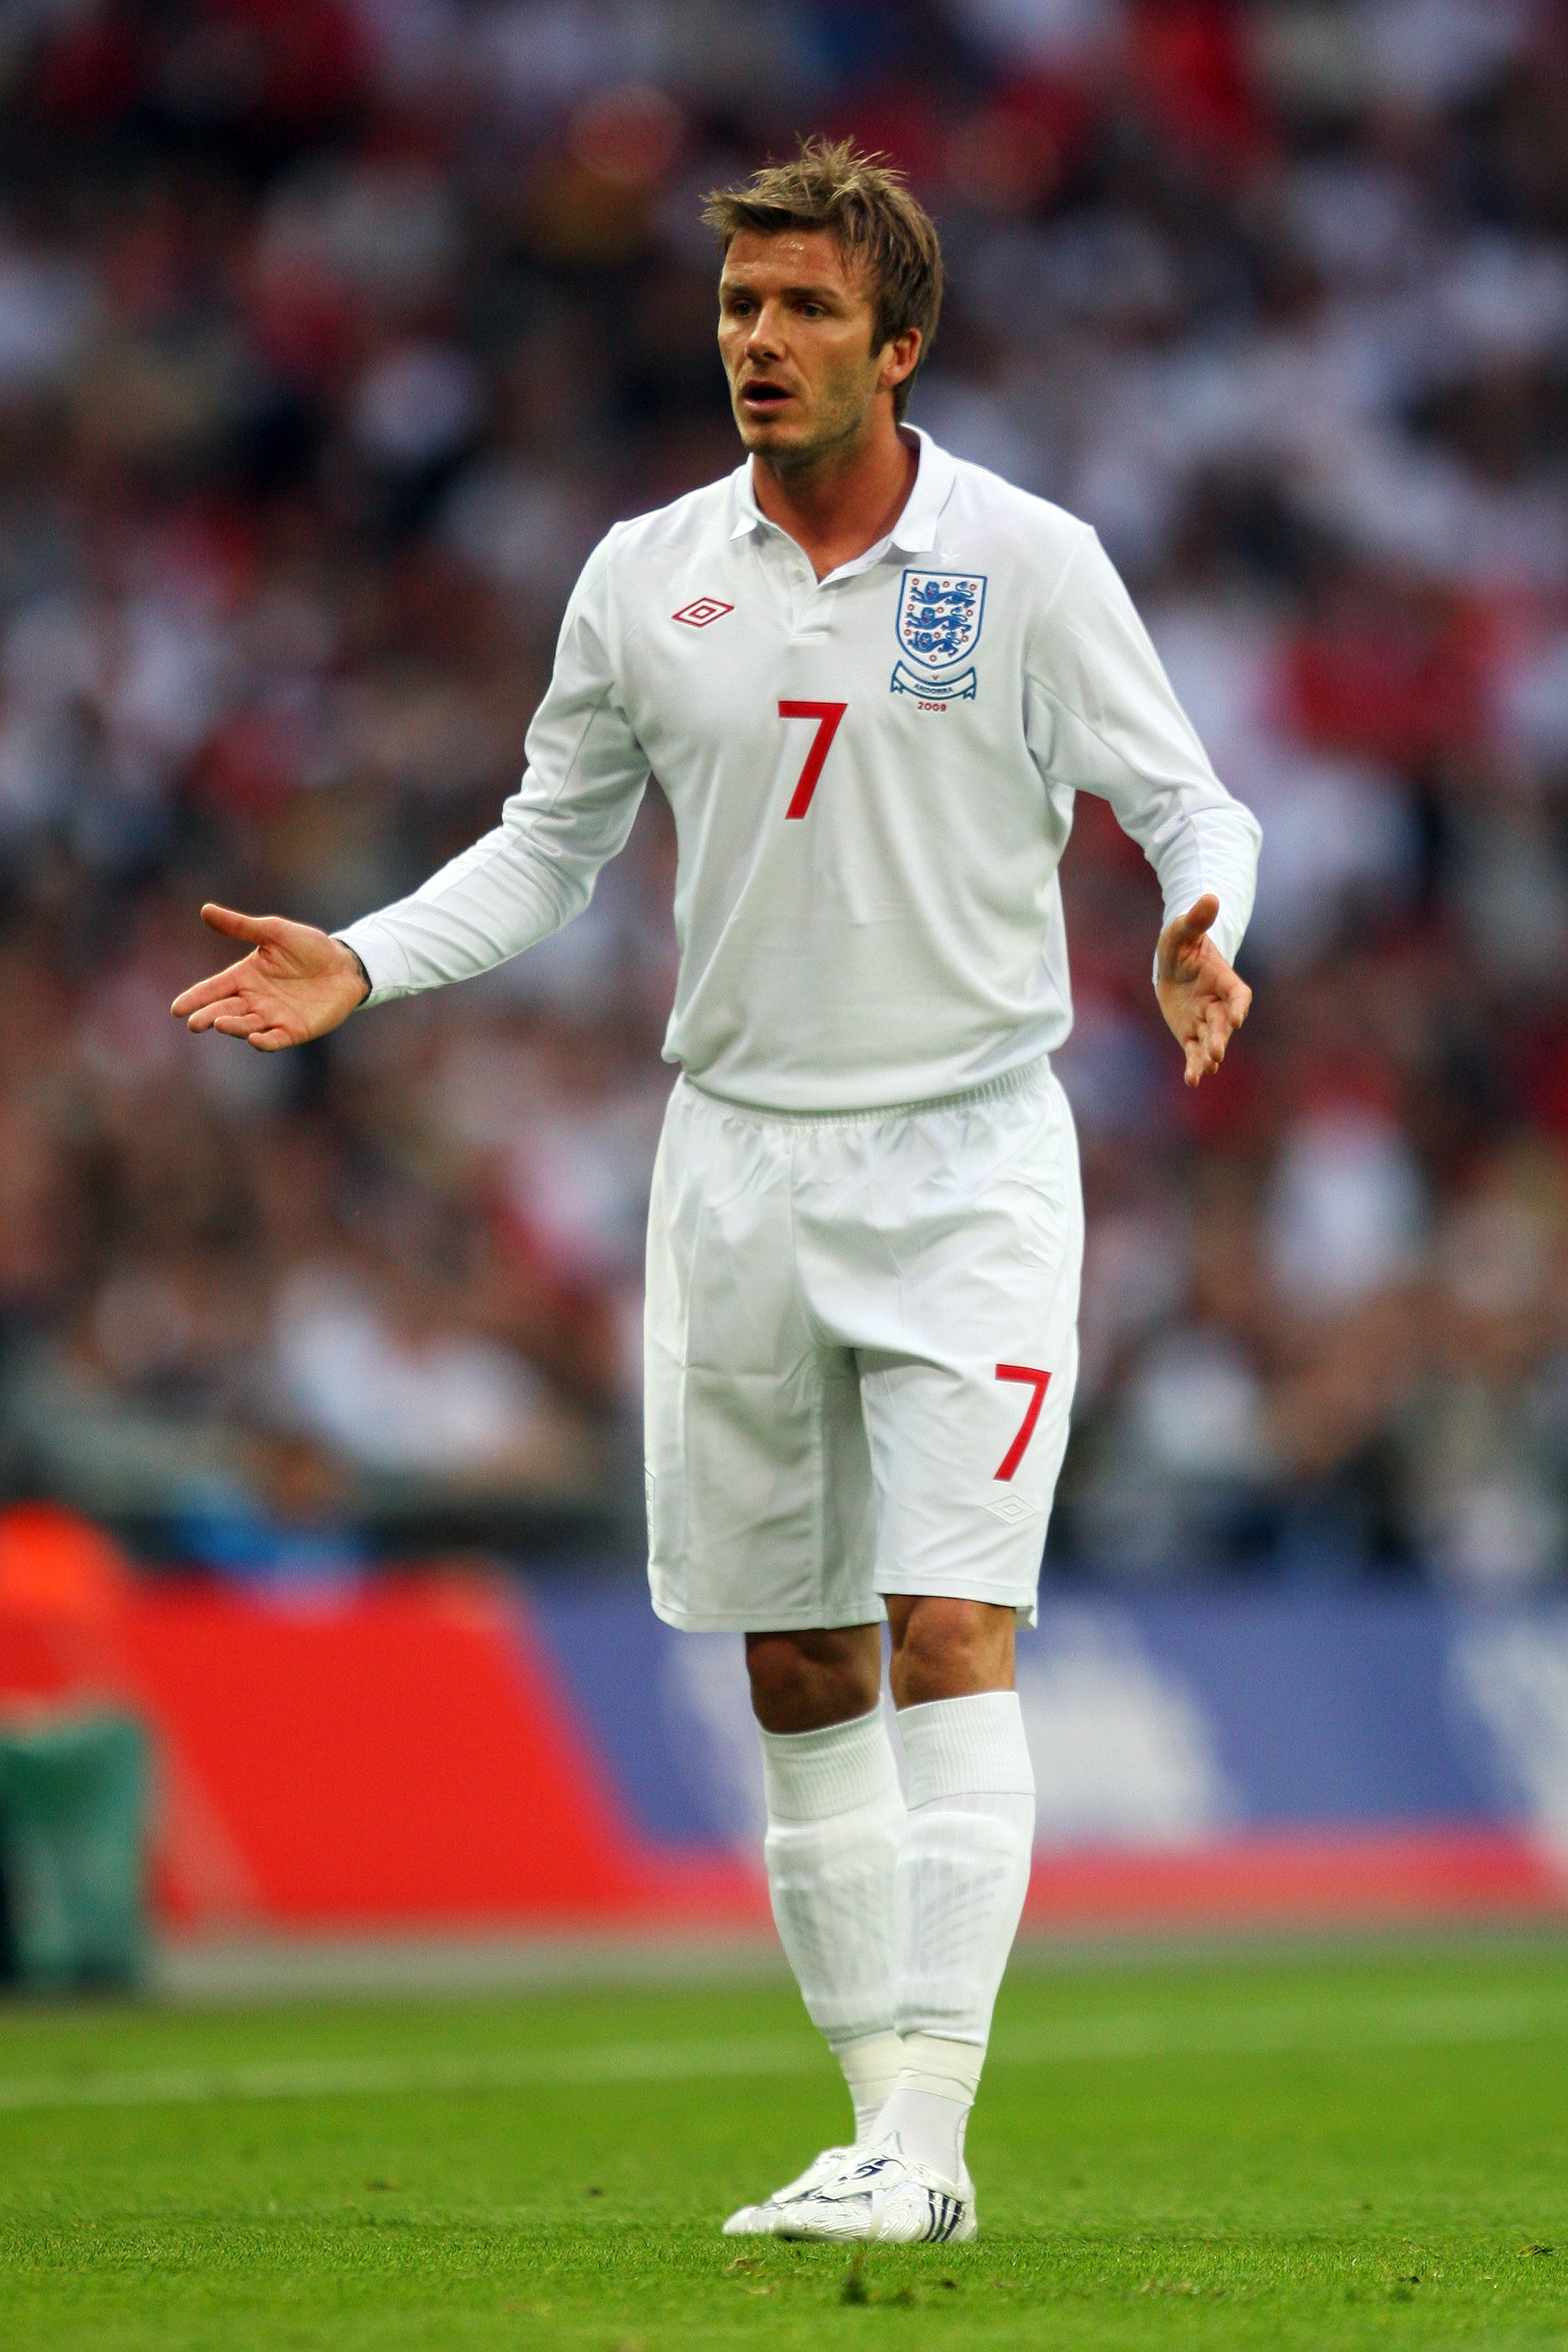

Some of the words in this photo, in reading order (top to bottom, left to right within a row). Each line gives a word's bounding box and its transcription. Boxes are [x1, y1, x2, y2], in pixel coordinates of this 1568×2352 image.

[778, 701, 848, 820] 7
[917, 702, 947, 712] 2009
[993, 1364, 1052, 1481] 7
